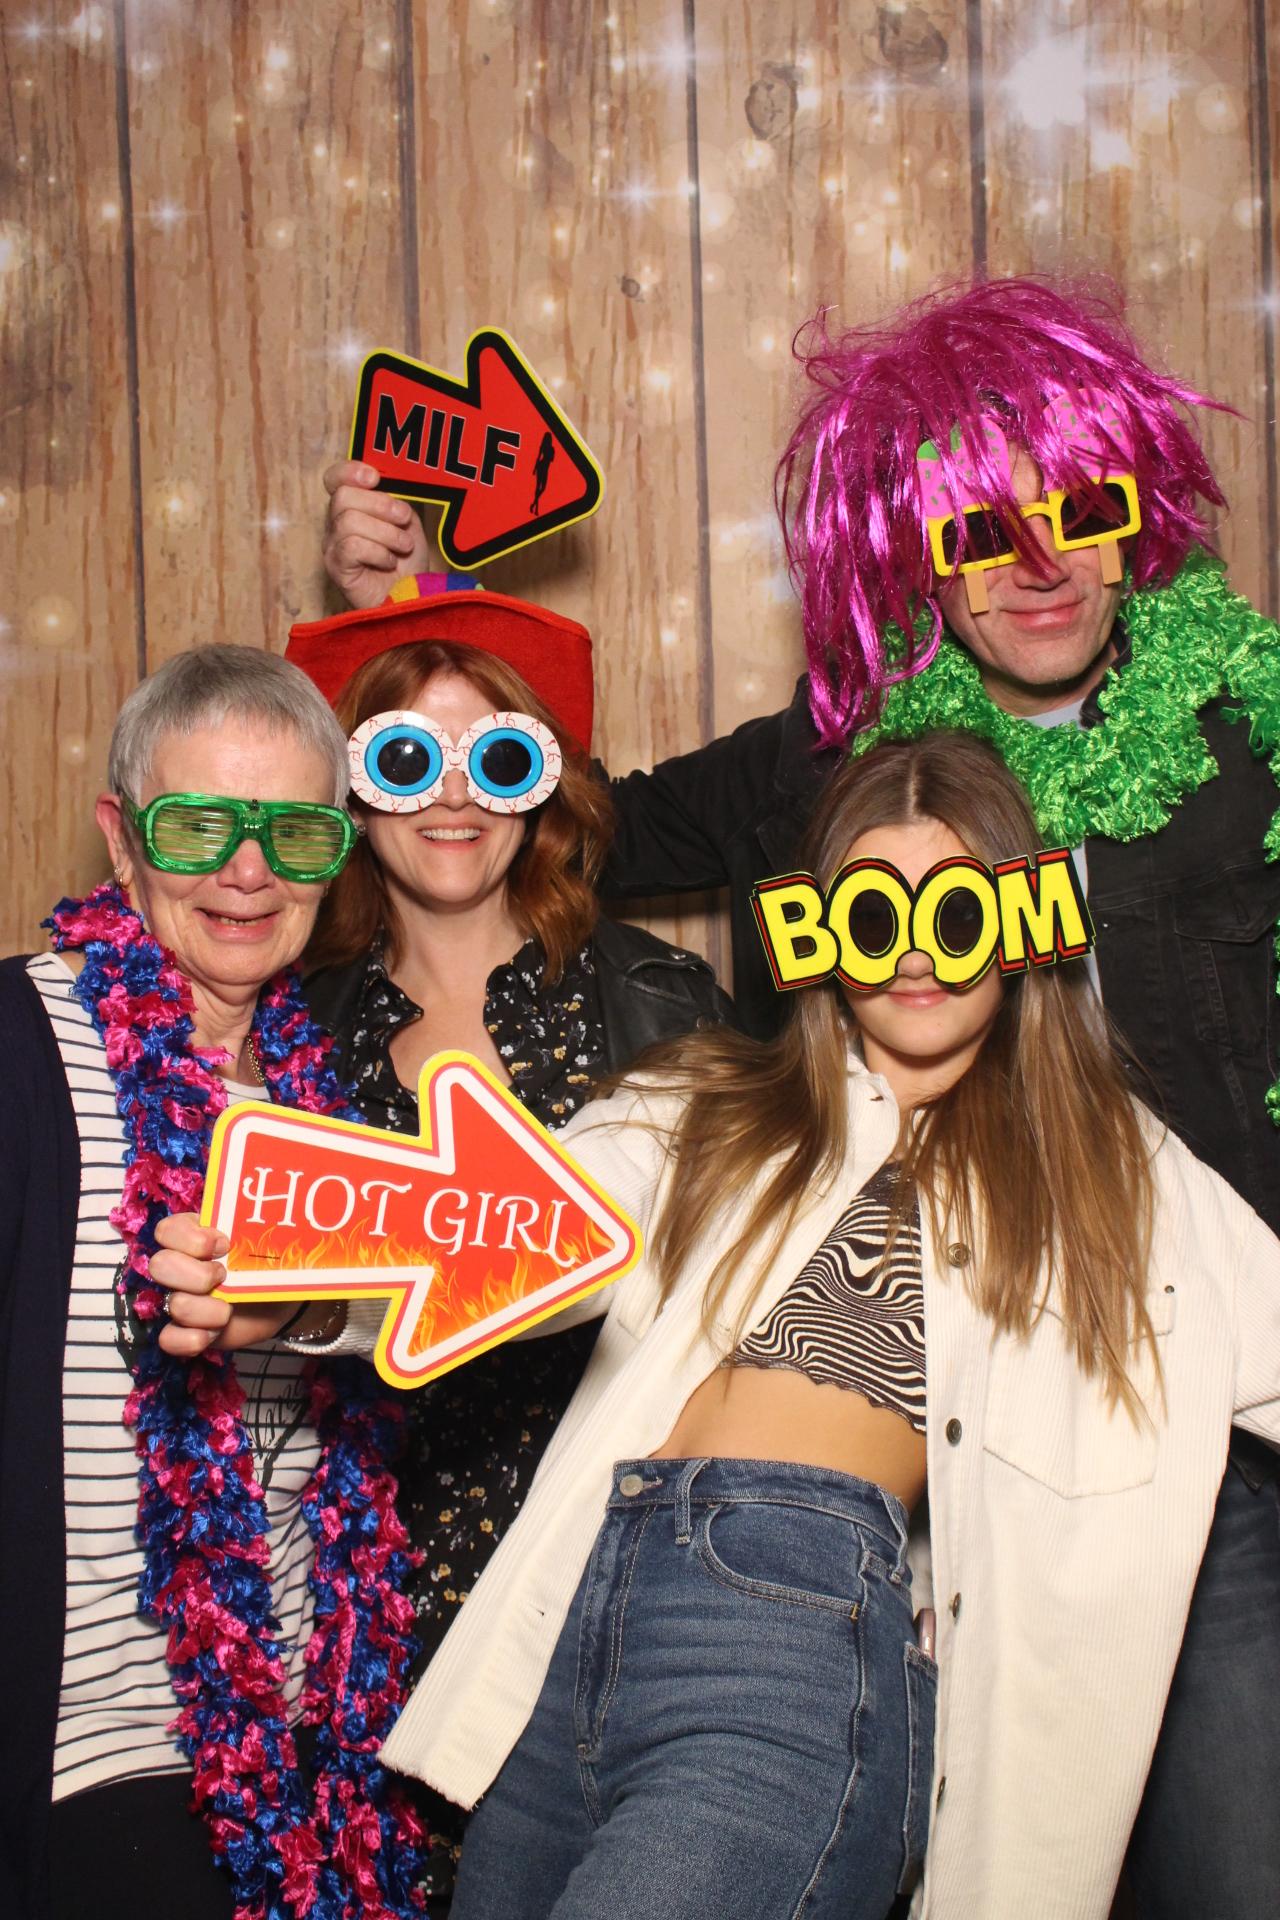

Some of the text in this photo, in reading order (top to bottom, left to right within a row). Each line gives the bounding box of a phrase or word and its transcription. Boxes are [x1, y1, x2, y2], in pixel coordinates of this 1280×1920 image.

[372, 392, 521, 488] MILF
[753, 850, 1093, 989] BOOM
[241, 1166, 578, 1269] HOT GIRL
